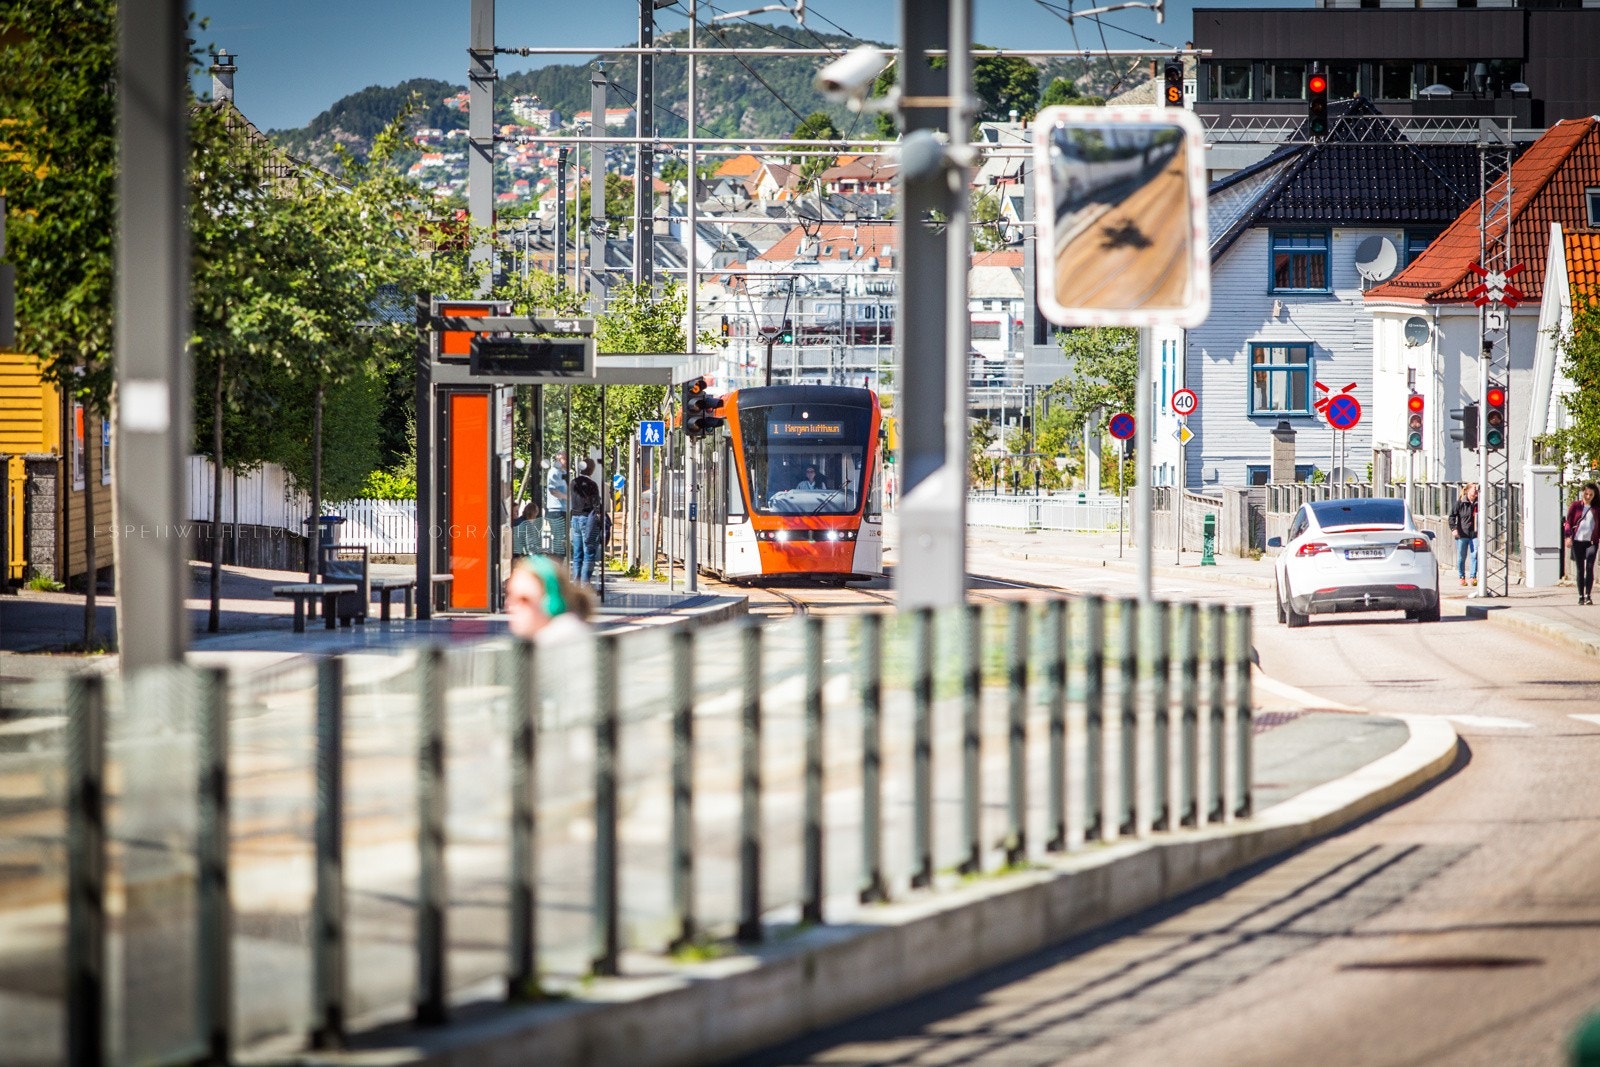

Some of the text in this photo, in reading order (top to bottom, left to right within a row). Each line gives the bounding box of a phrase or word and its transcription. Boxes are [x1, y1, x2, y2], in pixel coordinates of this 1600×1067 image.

[1168, 85, 1179, 102] S
[554, 320, 572, 330] Spor
[572, 320, 581, 332] 1
[1175, 395, 1193, 408] 40
